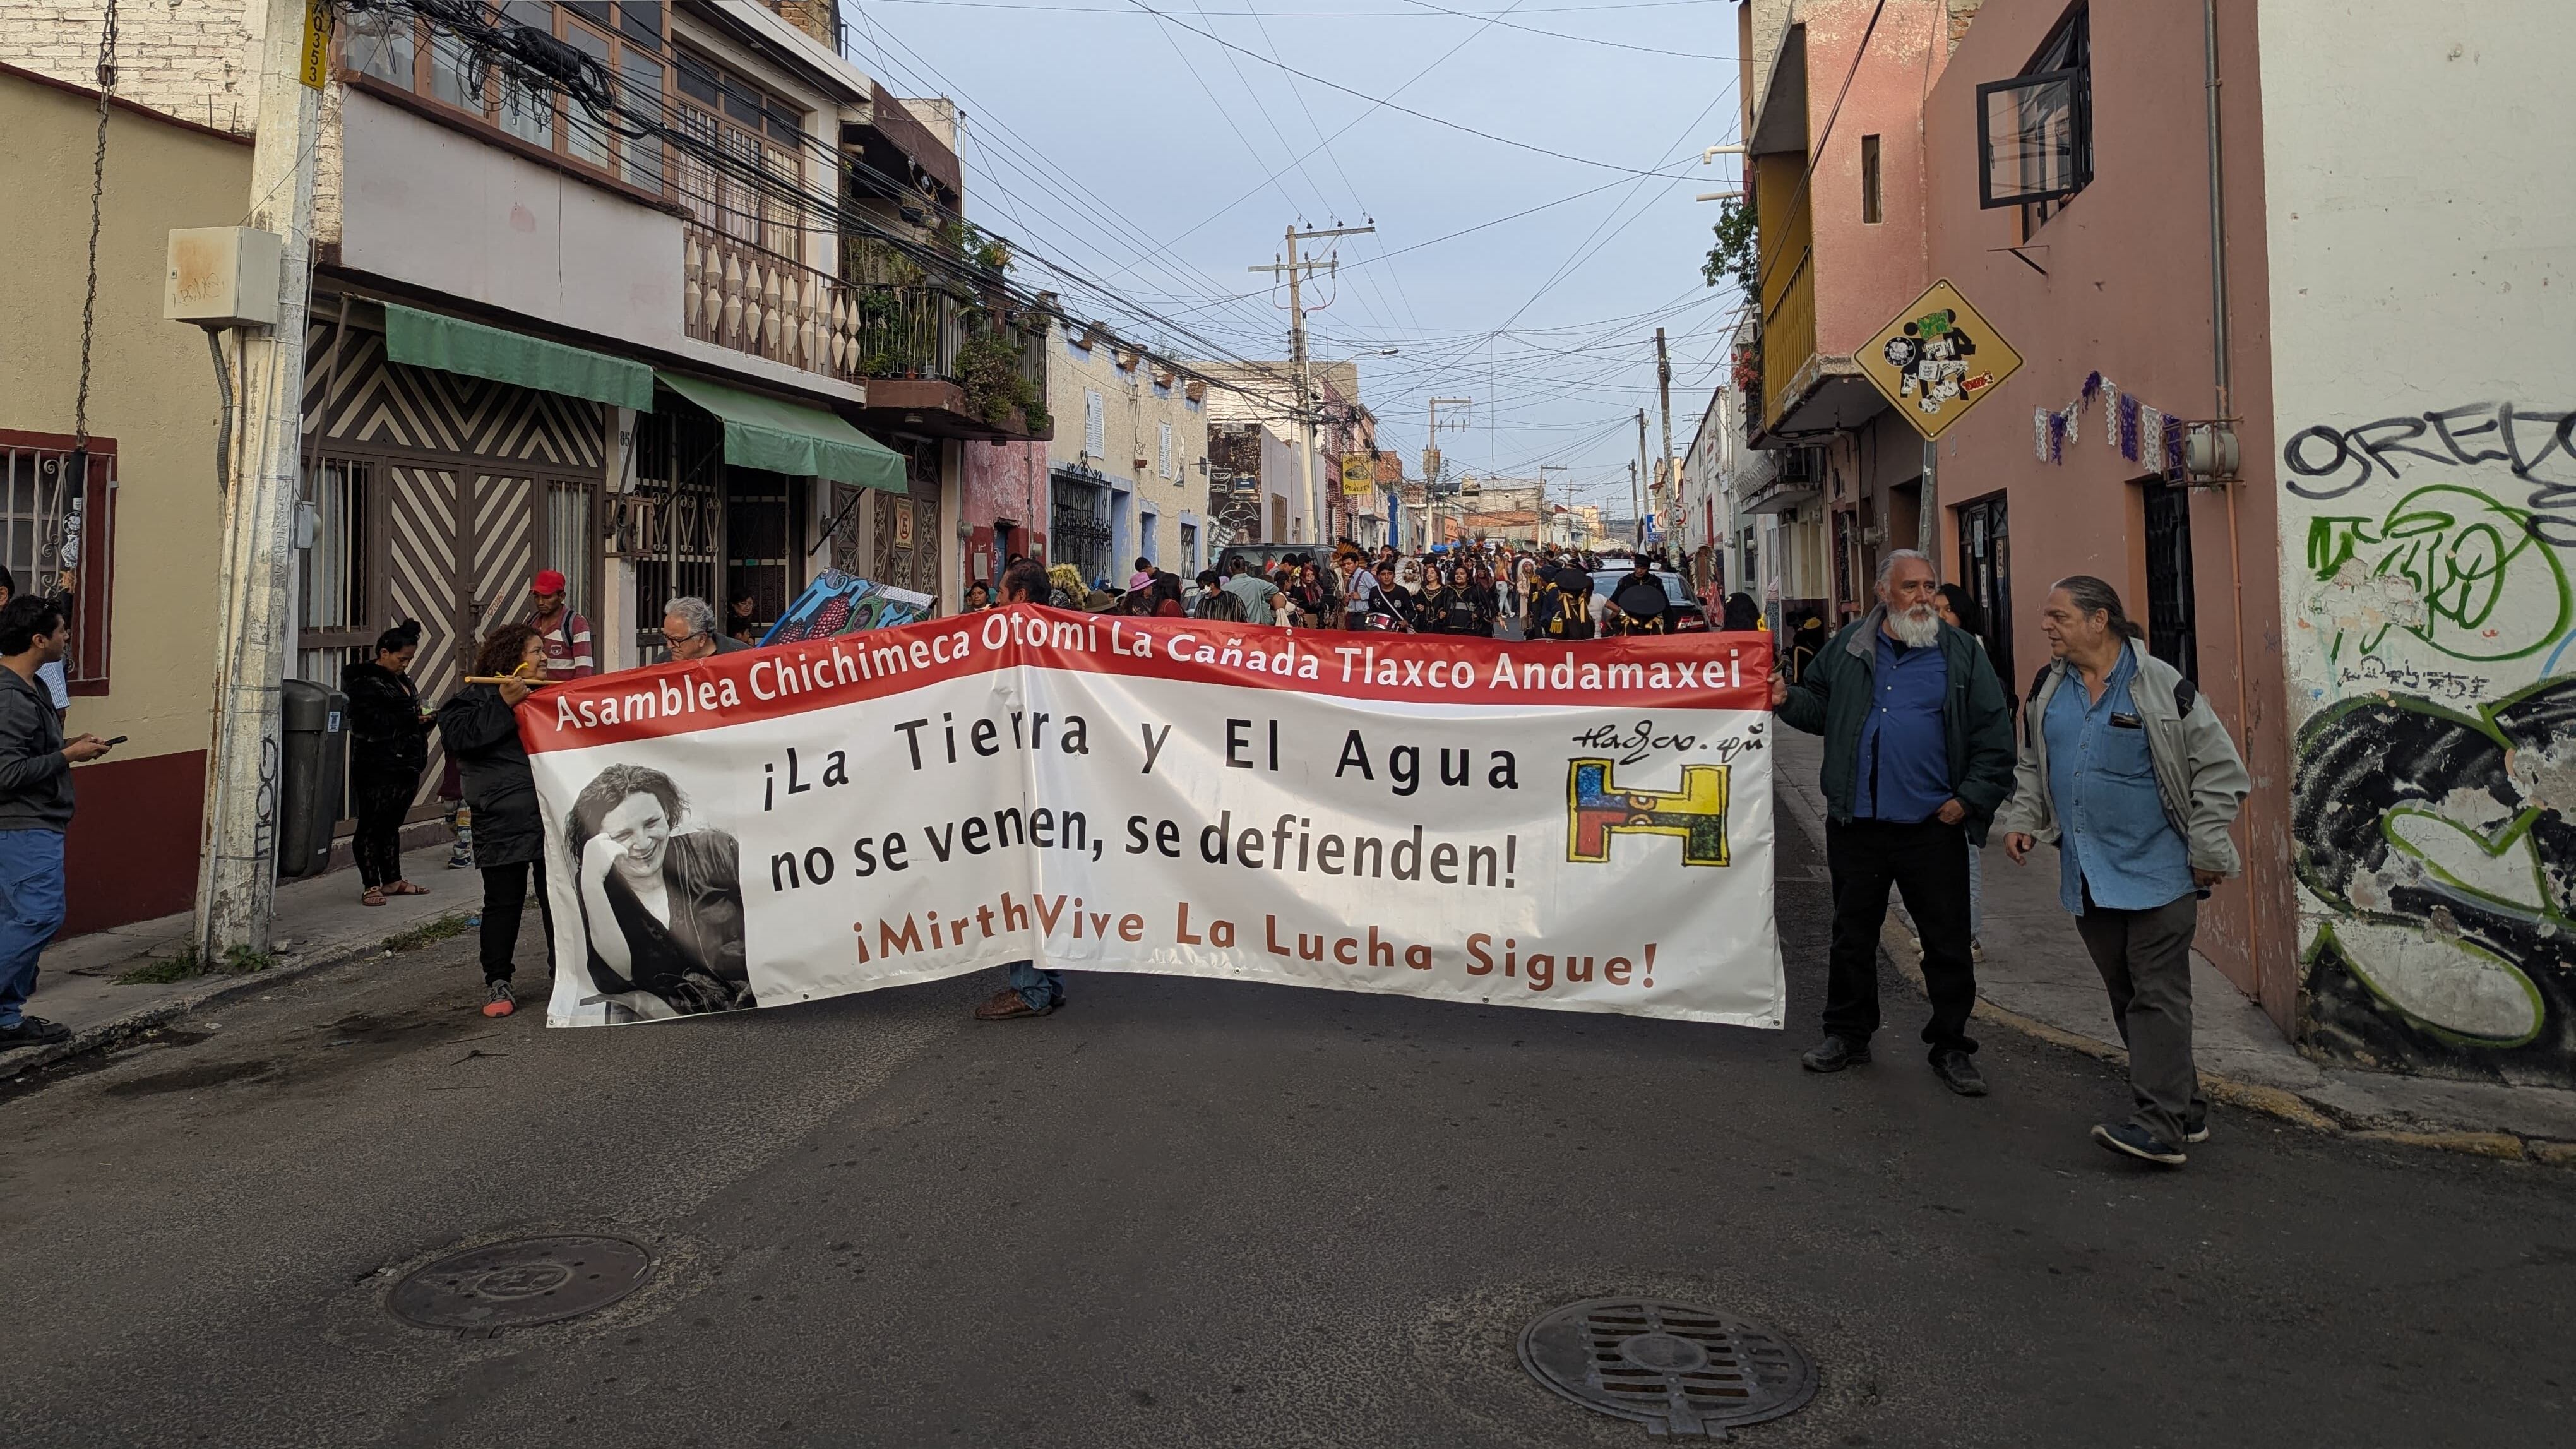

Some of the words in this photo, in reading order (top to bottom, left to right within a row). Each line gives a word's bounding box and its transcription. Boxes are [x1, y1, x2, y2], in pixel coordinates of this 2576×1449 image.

[620, 431, 630, 447] 85
[556, 673, 741, 732] Asamblea
[749, 631, 970, 701] Chichimeca
[982, 612, 1097, 651] Otomí
[1112, 621, 1152, 658] La
[1167, 634, 1319, 680] Cañada
[1335, 646, 1475, 689] Tlaxco
[1489, 650, 1741, 690] Andamaxei
[764, 748, 849, 812] ¡La
[894, 710, 1089, 771] Tierra
[1141, 723, 1171, 775] y
[1226, 718, 1279, 772] El
[1335, 729, 1519, 796] Agua
[772, 845, 835, 891] no
[854, 832, 909, 877] se
[924, 806, 1104, 863] venen,
[1125, 815, 1181, 858] se
[1200, 810, 1517, 889] defienden!
[1177, 902, 1235, 948] La
[1266, 914, 1433, 972] Lucha
[1467, 933, 1657, 991] Sigue!
